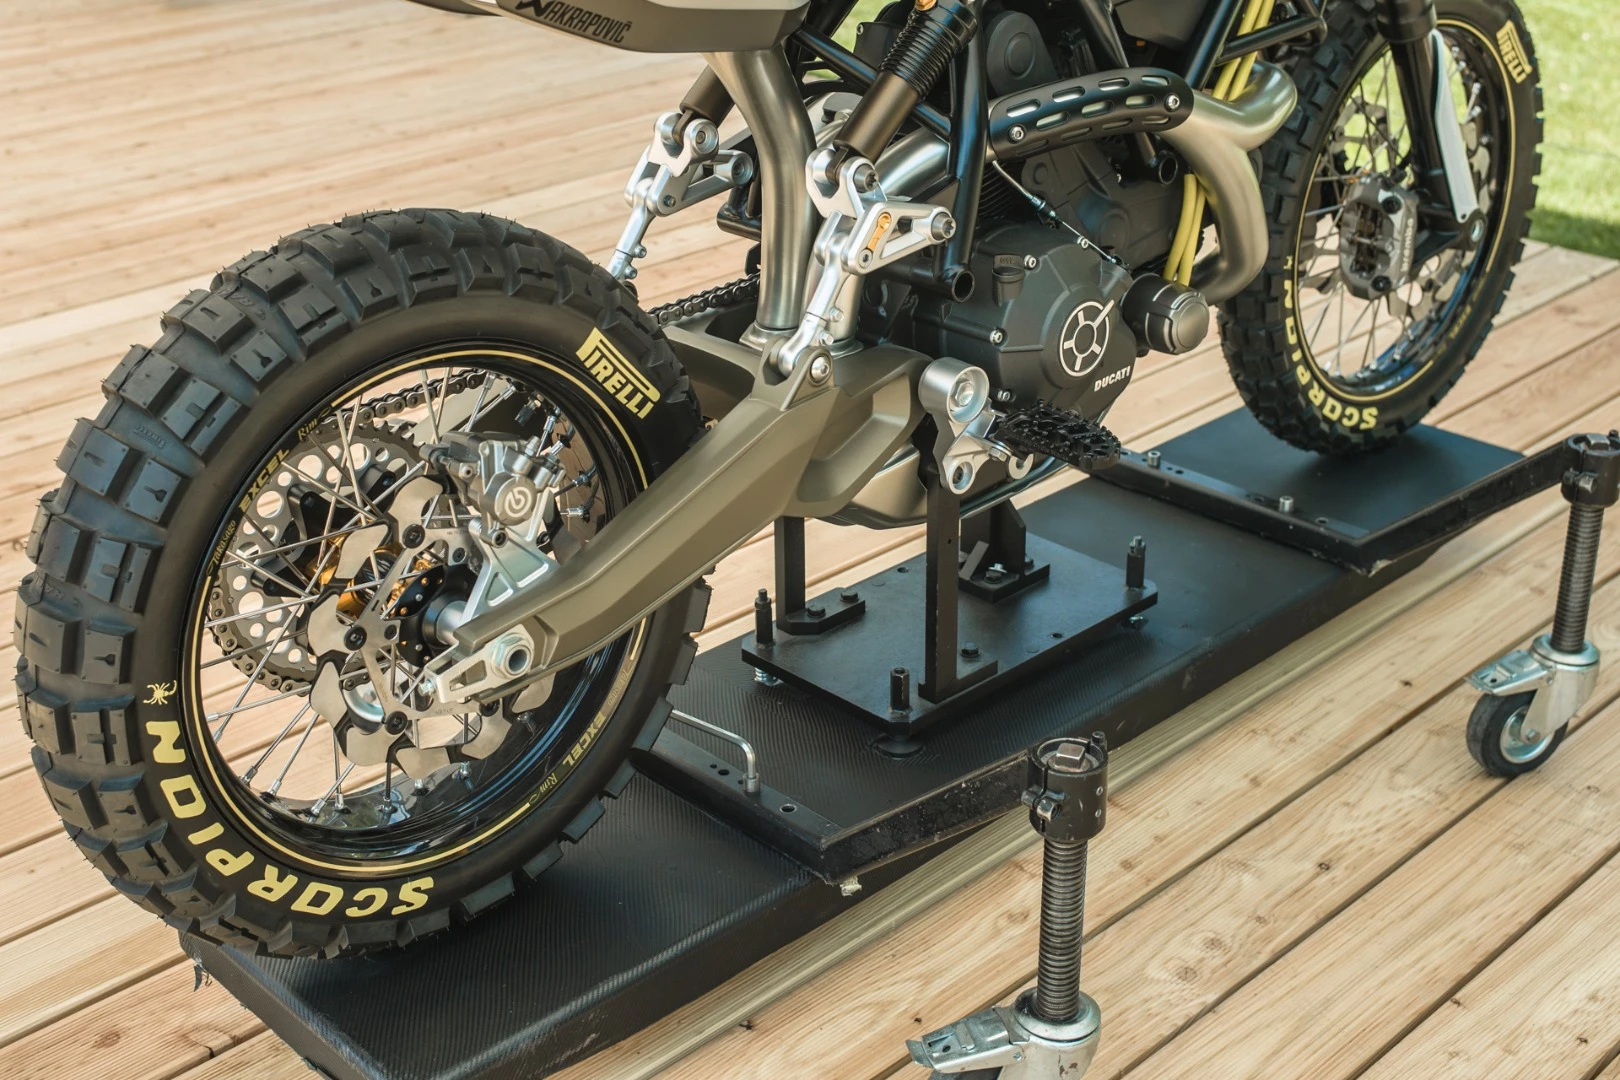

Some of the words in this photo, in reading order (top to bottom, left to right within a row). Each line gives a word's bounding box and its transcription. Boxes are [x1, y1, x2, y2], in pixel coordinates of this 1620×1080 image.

[1496, 19, 1533, 83] PIRELLI
[575, 326, 661, 419] PIRELLI
[1094, 365, 1131, 392] DUCATI
[1283, 279, 1379, 430] SCORPION
[208, 519, 236, 571] Takasago
[238, 448, 290, 513] EXCEL
[297, 413, 324, 441] Rim
[562, 711, 607, 767] EXCEL
[145, 720, 435, 918] SCORPION
